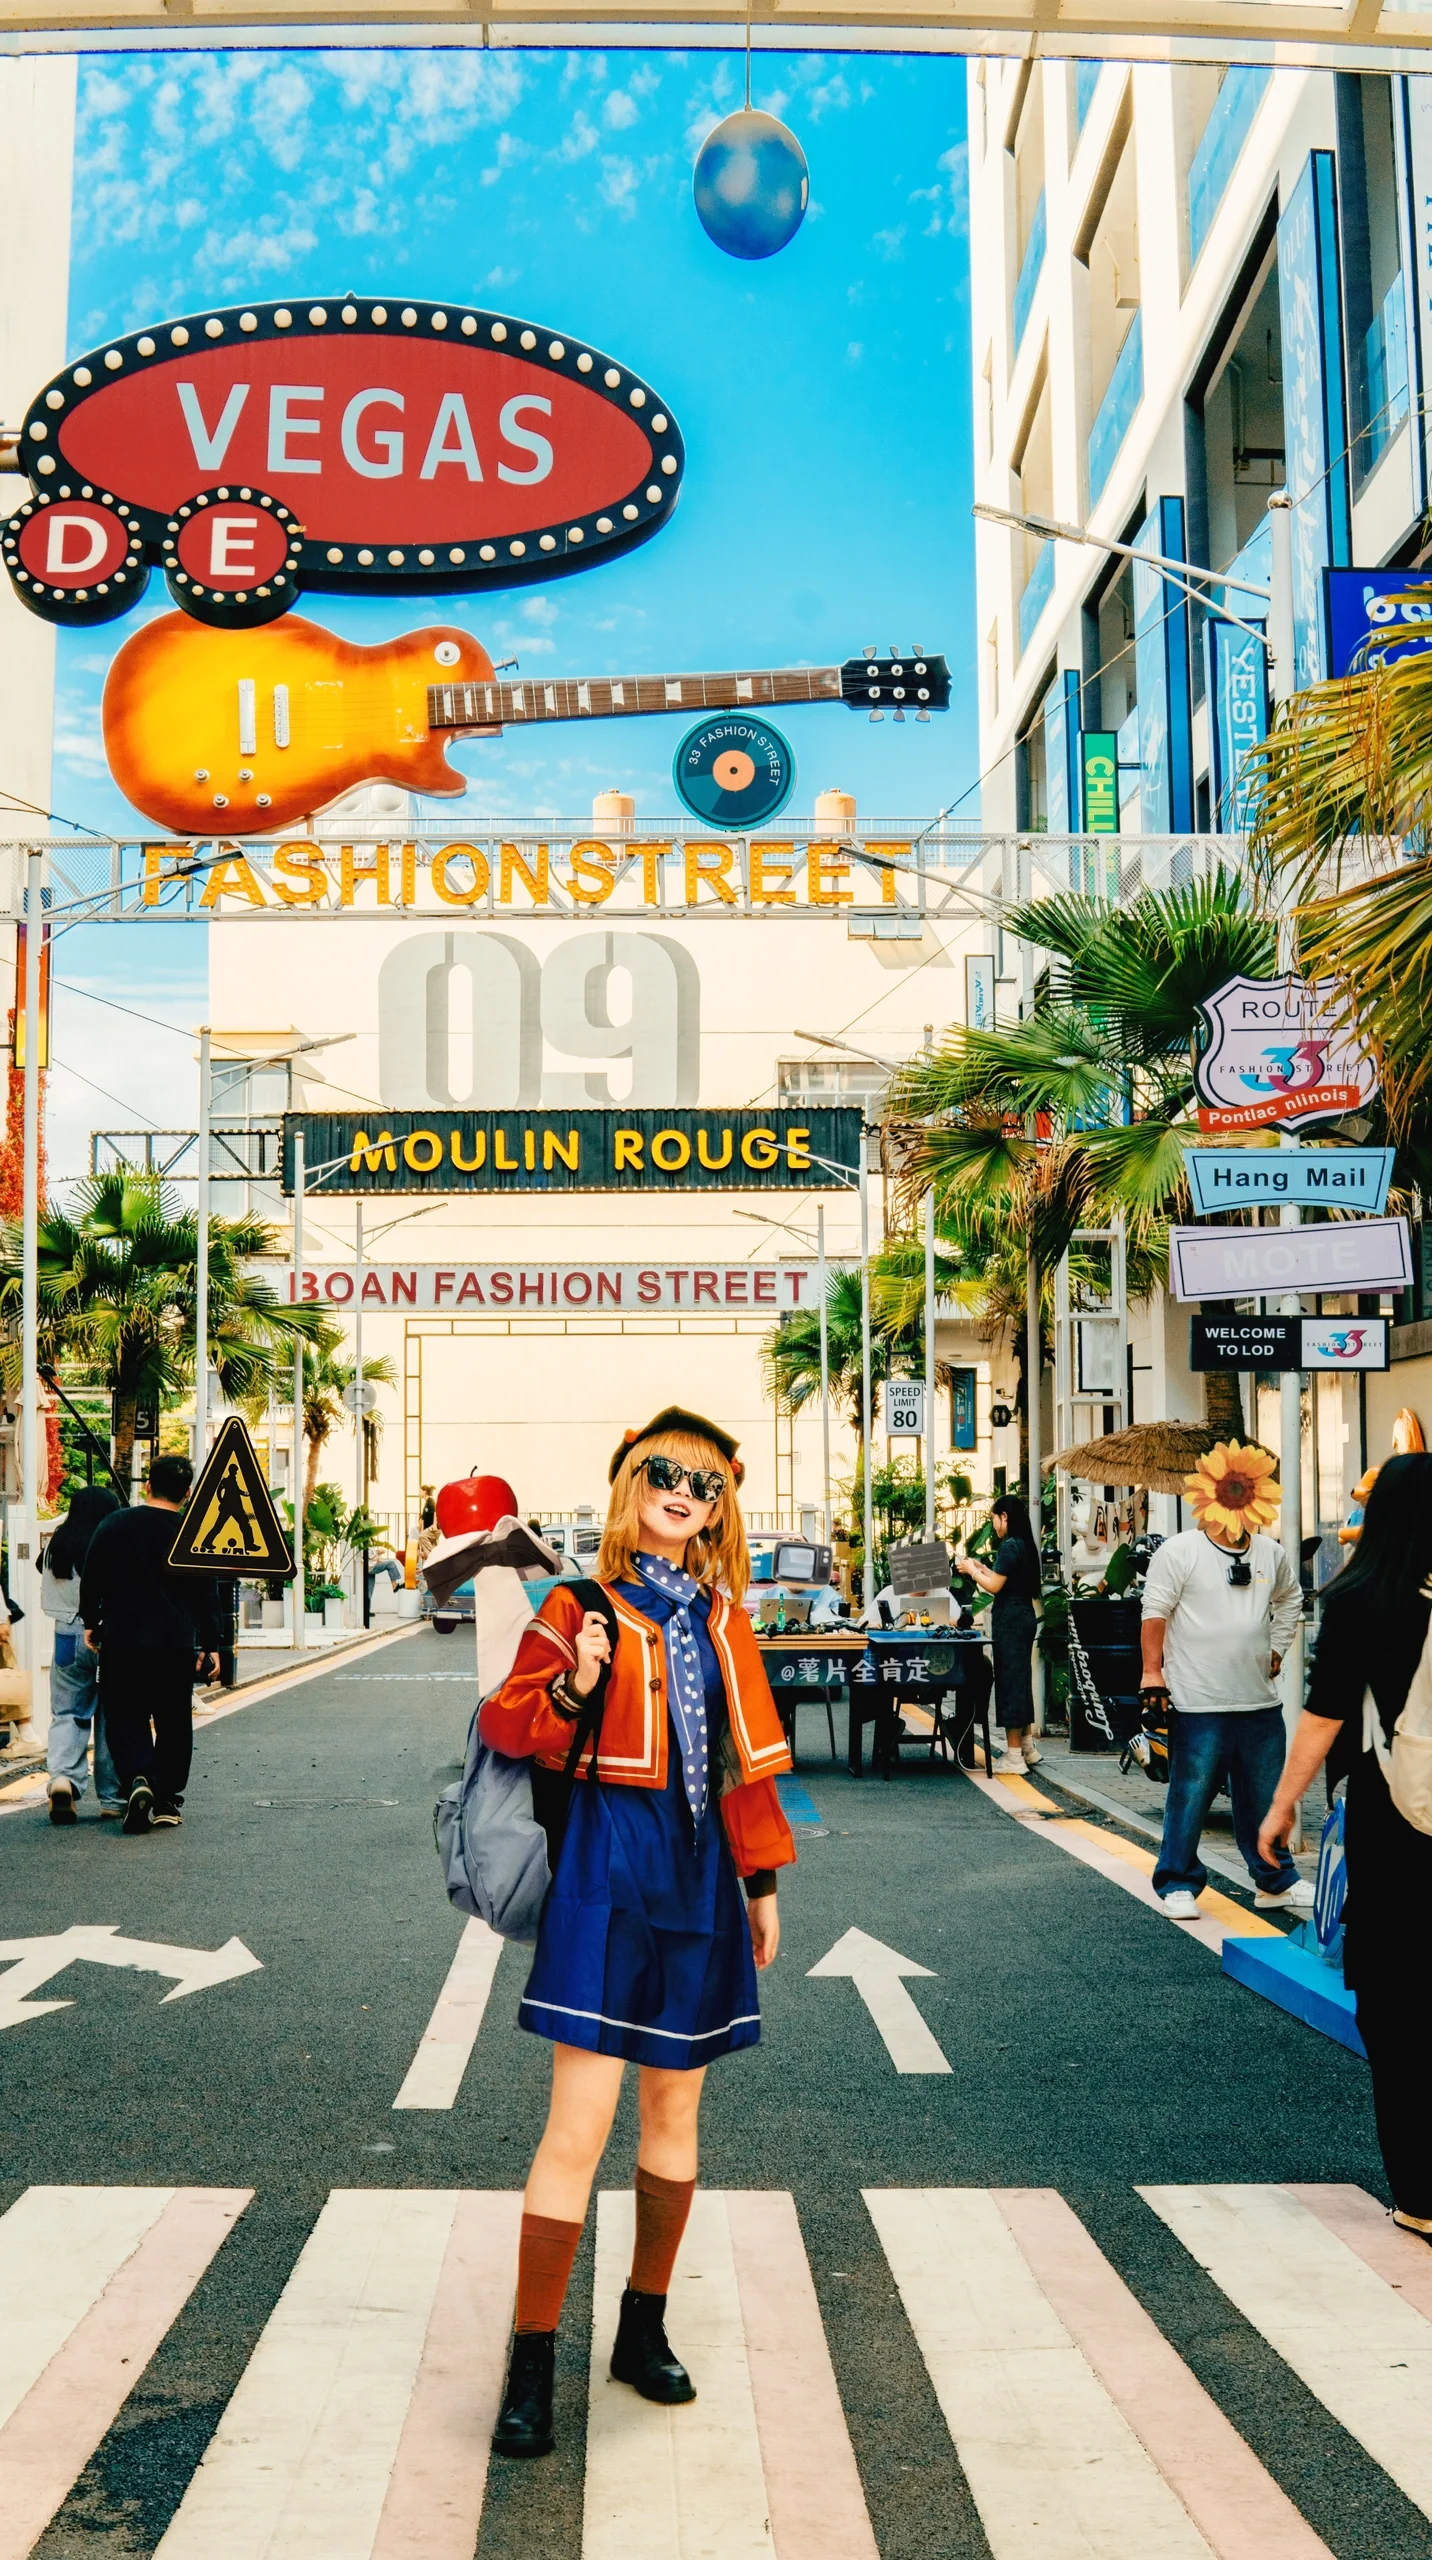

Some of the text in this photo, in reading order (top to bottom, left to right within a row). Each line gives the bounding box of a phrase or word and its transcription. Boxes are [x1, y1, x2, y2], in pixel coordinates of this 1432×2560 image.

[176, 383, 555, 485] VEGAS
[47, 515, 108, 573] D
[209, 517, 258, 576] E
[688, 725, 781, 787] 33 FASHION STREET
[378, 930, 700, 1112] 09
[1242, 1000, 1338, 1019] ROUTE
[1220, 1064, 1284, 1074] FASHION
[350, 1128, 812, 1172] MOULIN ROUGE
[1213, 1167, 1366, 1192] Hang Mail
[1221, 1240, 1360, 1279] MOTE
[289, 1270, 808, 1304] BOAN FASHION STREET
[1205, 1327, 1286, 1339] WELCOME
[1217, 1344, 1275, 1356] TO LOD
[889, 1387, 921, 1397] SPEED
[893, 1398, 917, 1407] LIMIT
[893, 1410, 918, 1428] 80
